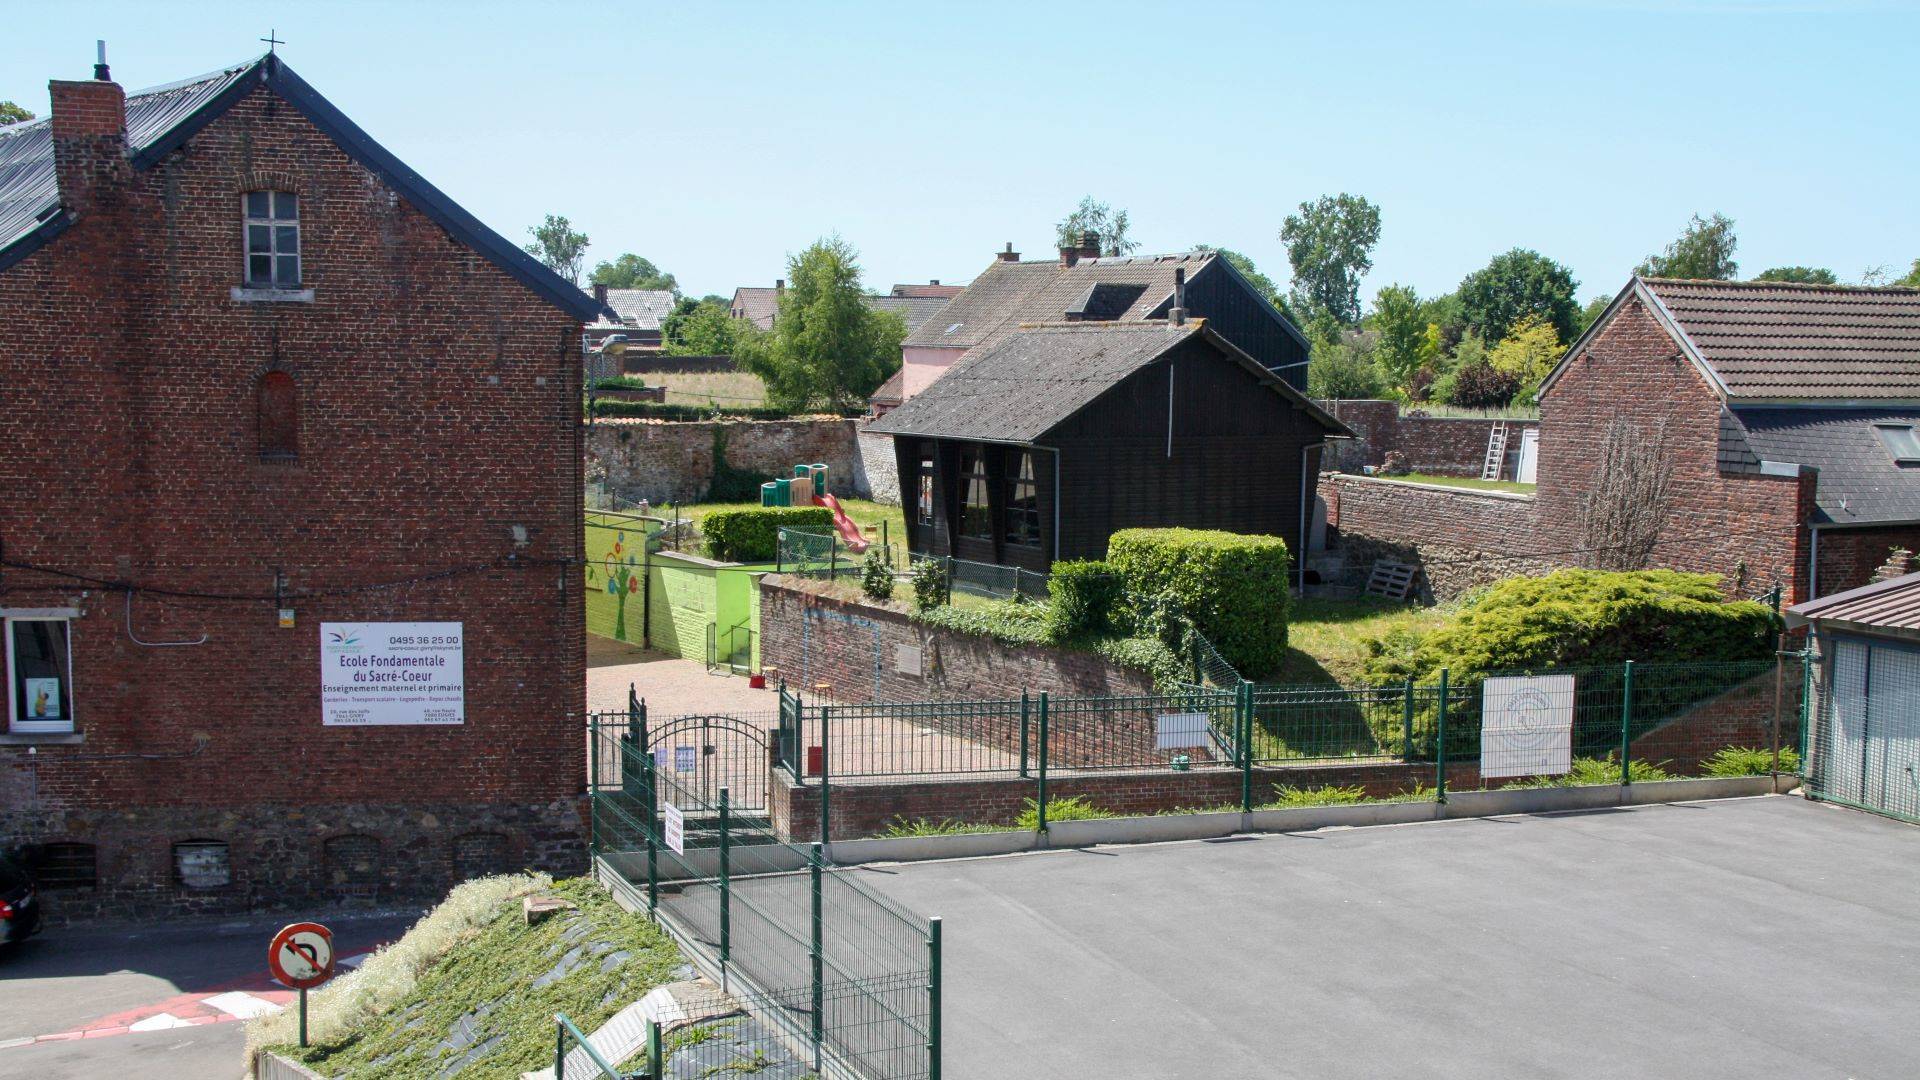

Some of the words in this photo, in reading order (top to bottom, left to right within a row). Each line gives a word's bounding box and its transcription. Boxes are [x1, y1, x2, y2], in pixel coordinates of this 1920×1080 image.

[390, 636, 415, 644] 0495
[417, 636, 429, 644] 36
[431, 636, 444, 644] 25
[446, 636, 459, 644] 00
[340, 655, 368, 667] Ecole
[371, 655, 445, 667] Fondamentale
[353, 670, 366, 682] du
[369, 670, 433, 682] Sacré-Coeur
[323, 685, 379, 694] Enseignement
[381, 684, 417, 692] maternel
[418, 684, 427, 692] et
[428, 684, 462, 694] primaire
